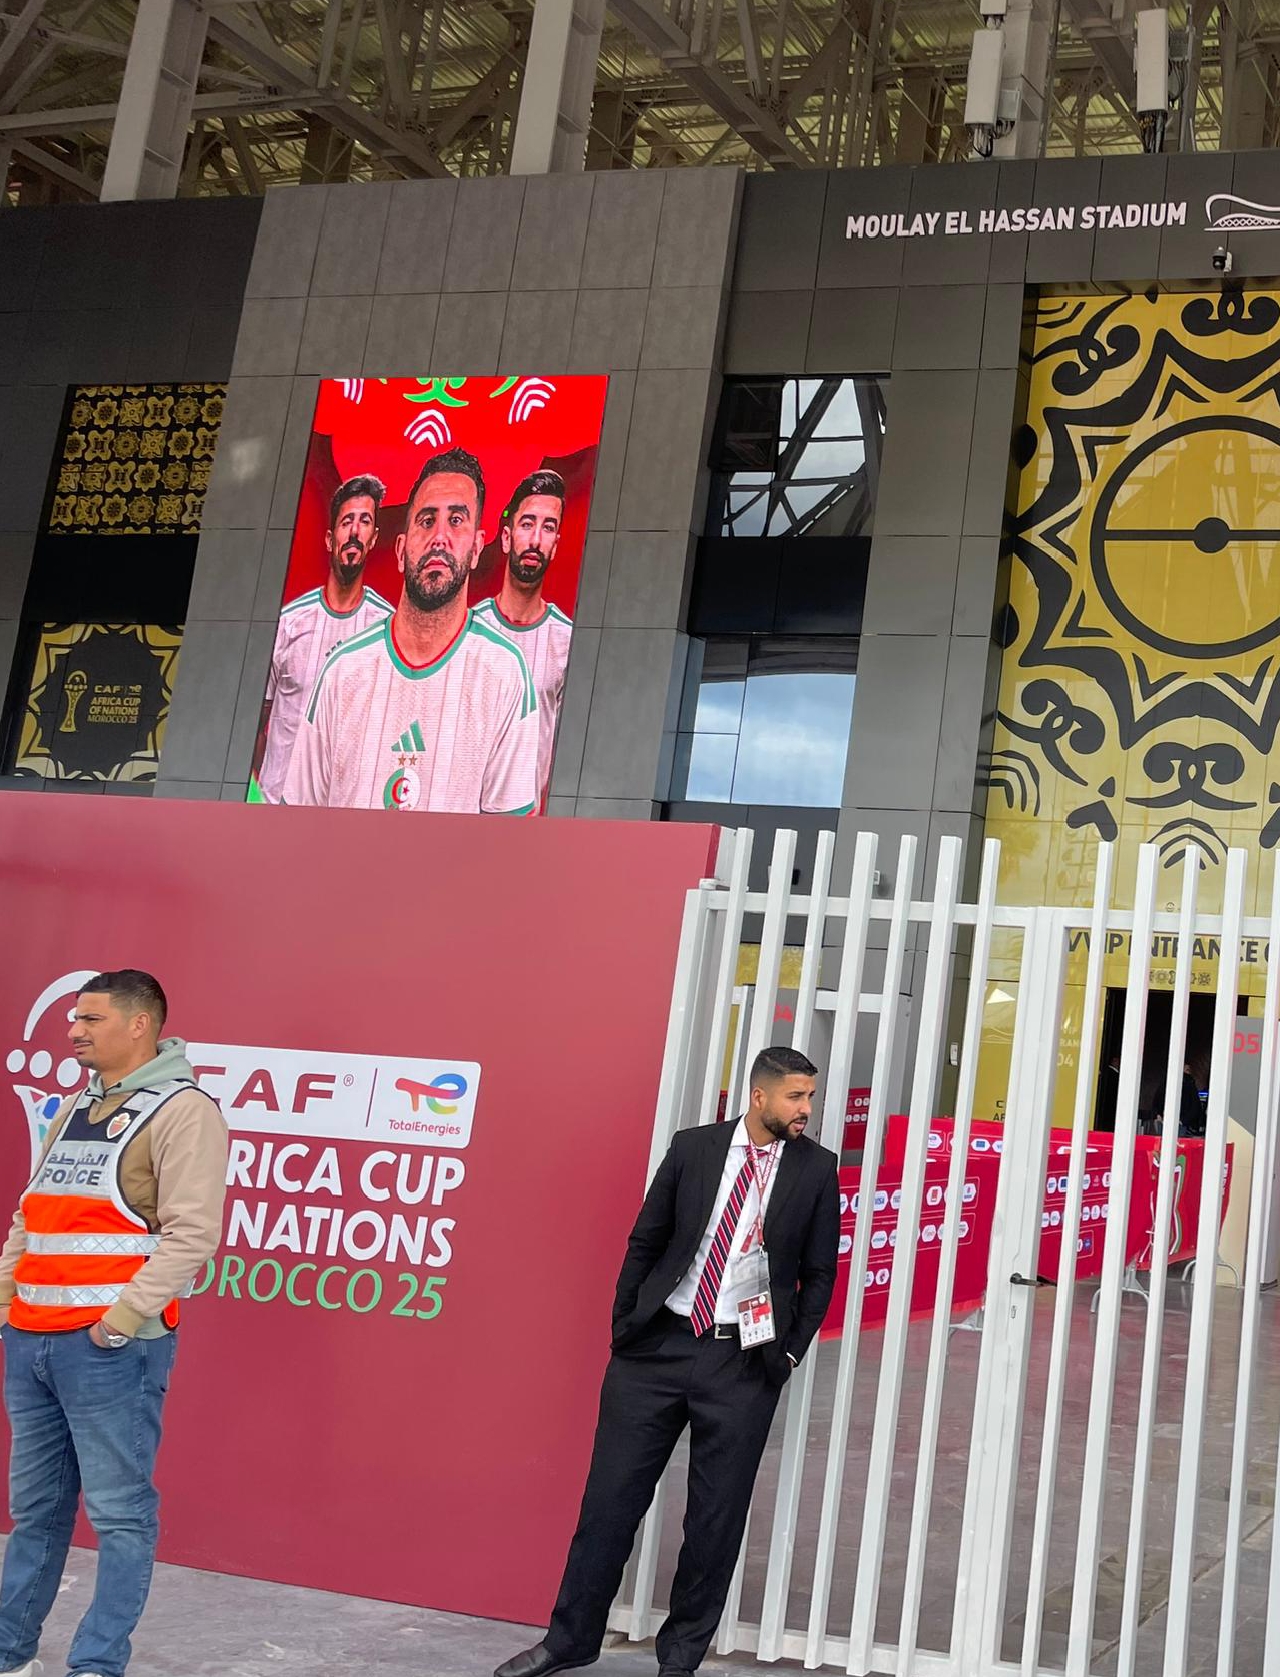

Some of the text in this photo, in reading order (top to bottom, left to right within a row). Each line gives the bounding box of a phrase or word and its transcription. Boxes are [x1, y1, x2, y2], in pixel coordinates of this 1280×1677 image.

[845, 202, 1188, 239] MOULAY EL HASSAN STADIUM
[94, 684, 121, 694] CAF
[89, 705, 139, 716] OF NATIONS
[91, 697, 141, 706] AFRICA CUP
[87, 714, 128, 724] MOROCCO
[1232, 1033, 1261, 1054] 05
[389, 1119, 461, 1136] TotalEnergies
[225, 1139, 466, 1206] RICA CUP
[226, 1199, 457, 1268] NATIONS
[390, 1272, 448, 1320] 25
